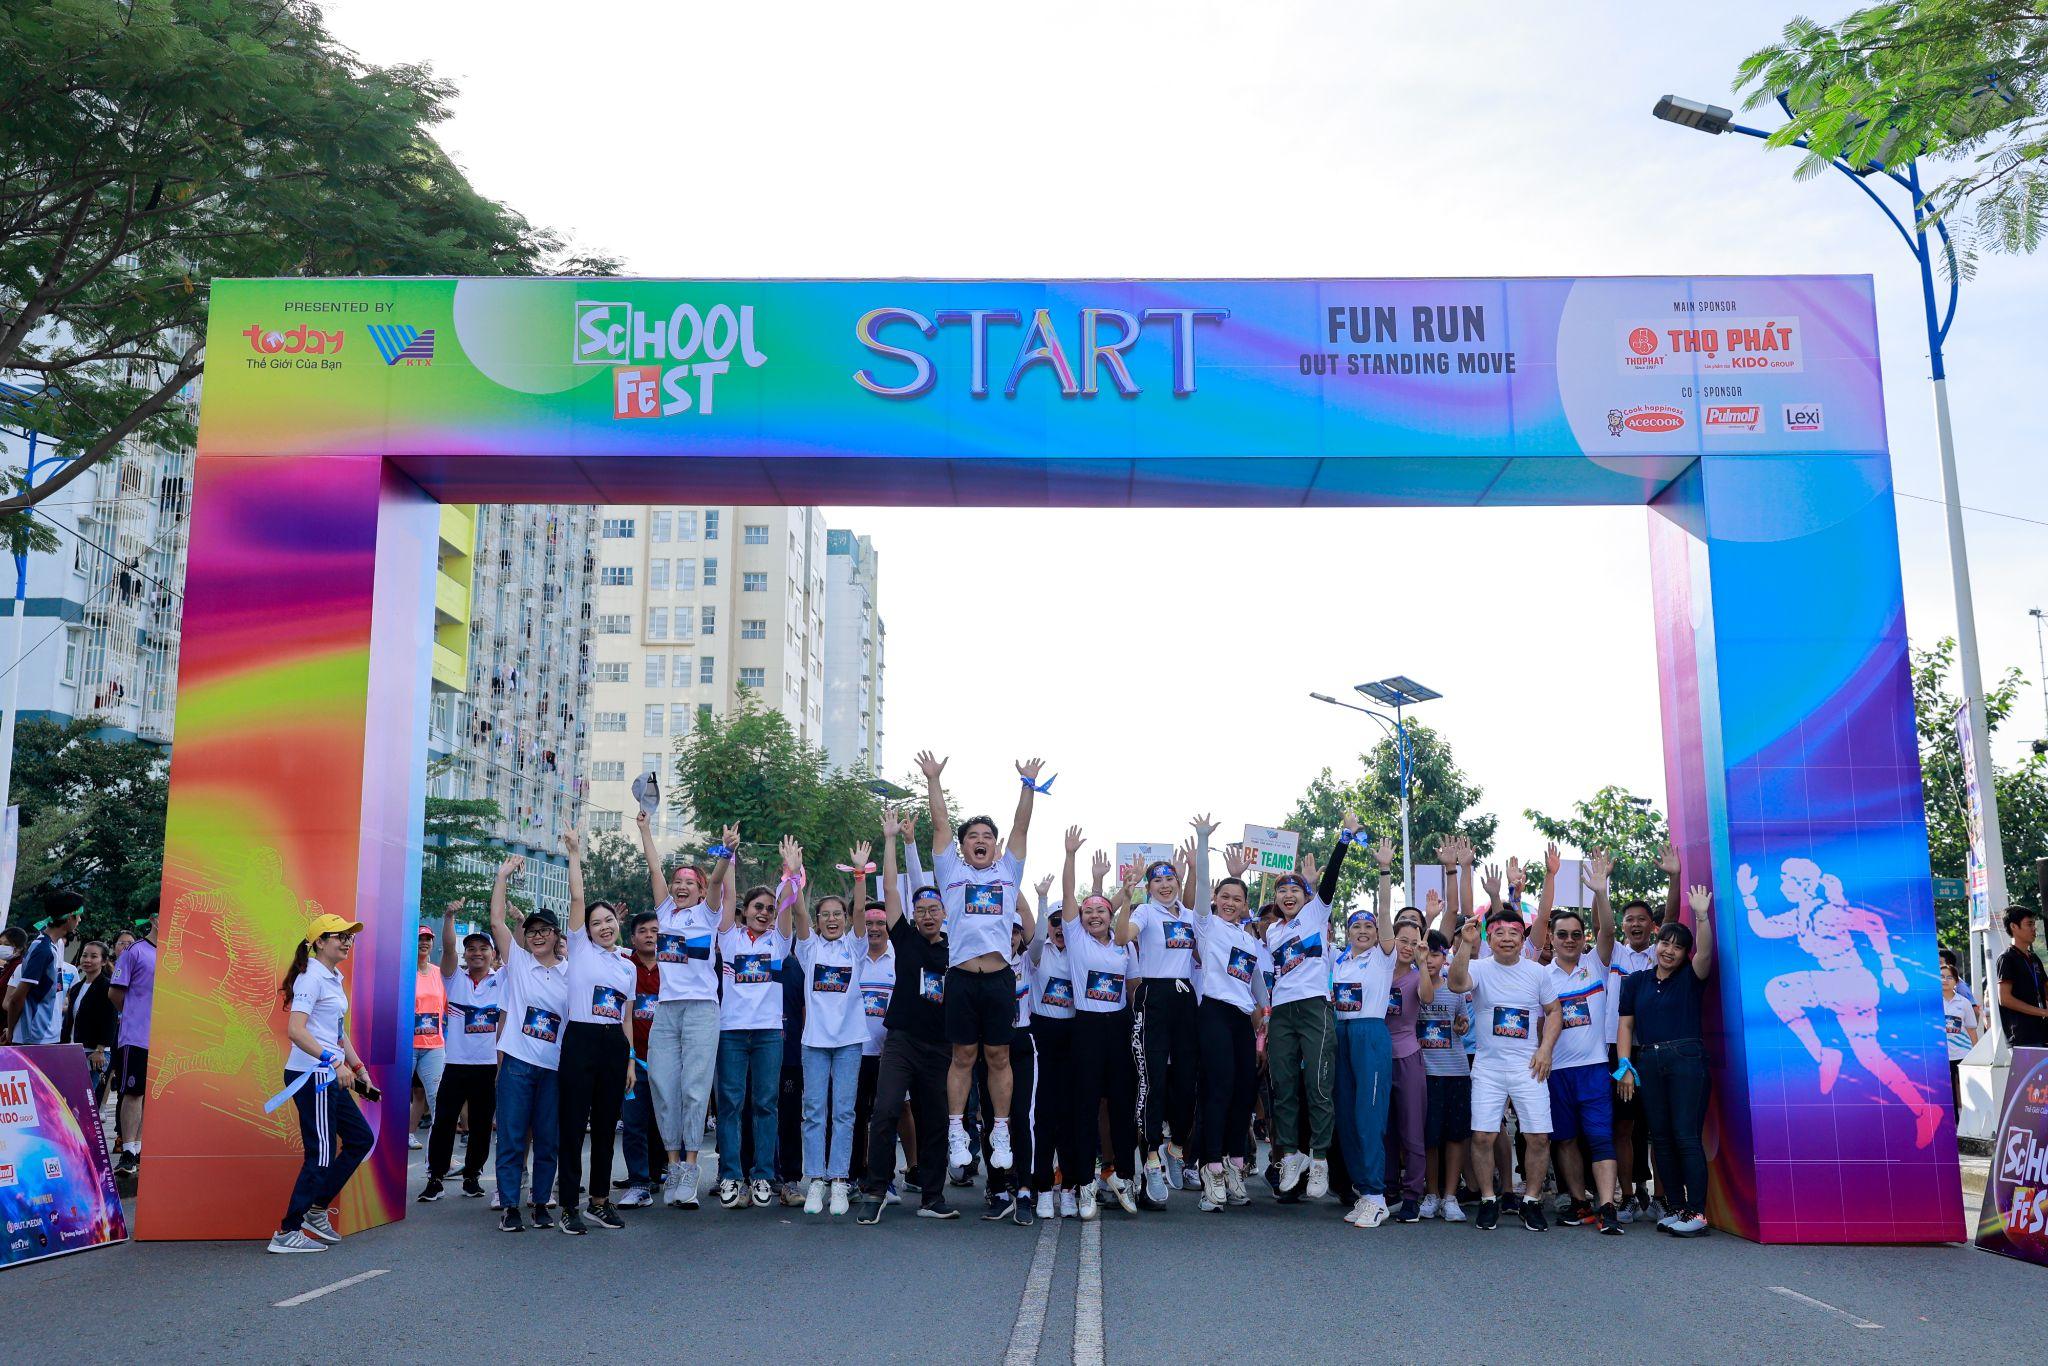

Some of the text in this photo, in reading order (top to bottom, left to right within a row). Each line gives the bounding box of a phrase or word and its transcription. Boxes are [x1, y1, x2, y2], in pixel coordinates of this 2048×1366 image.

[284, 302, 395, 312] PRESENTED BY
[1673, 301, 1737, 312] MAIN SPONSOR
[573, 300, 768, 368] SCHOOL
[1328, 305, 1485, 343] FUN RUN
[243, 324, 345, 355] today
[1667, 321, 1793, 359] THỌ PHÁT
[853, 306, 1231, 394] START
[247, 357, 342, 371] Thế Giới Của Bạn
[1299, 353, 1516, 376] OUT STANDING MOVE
[1732, 357, 1768, 368] KIDO
[613, 361, 730, 418] FEST
[1681, 387, 1693, 398] CO
[1704, 386, 1742, 398] SPONSOR
[1623, 404, 1684, 416] Cook happiness
[1708, 408, 1756, 423] Pulmoll
[1261, 851, 1294, 871] TEAMS
